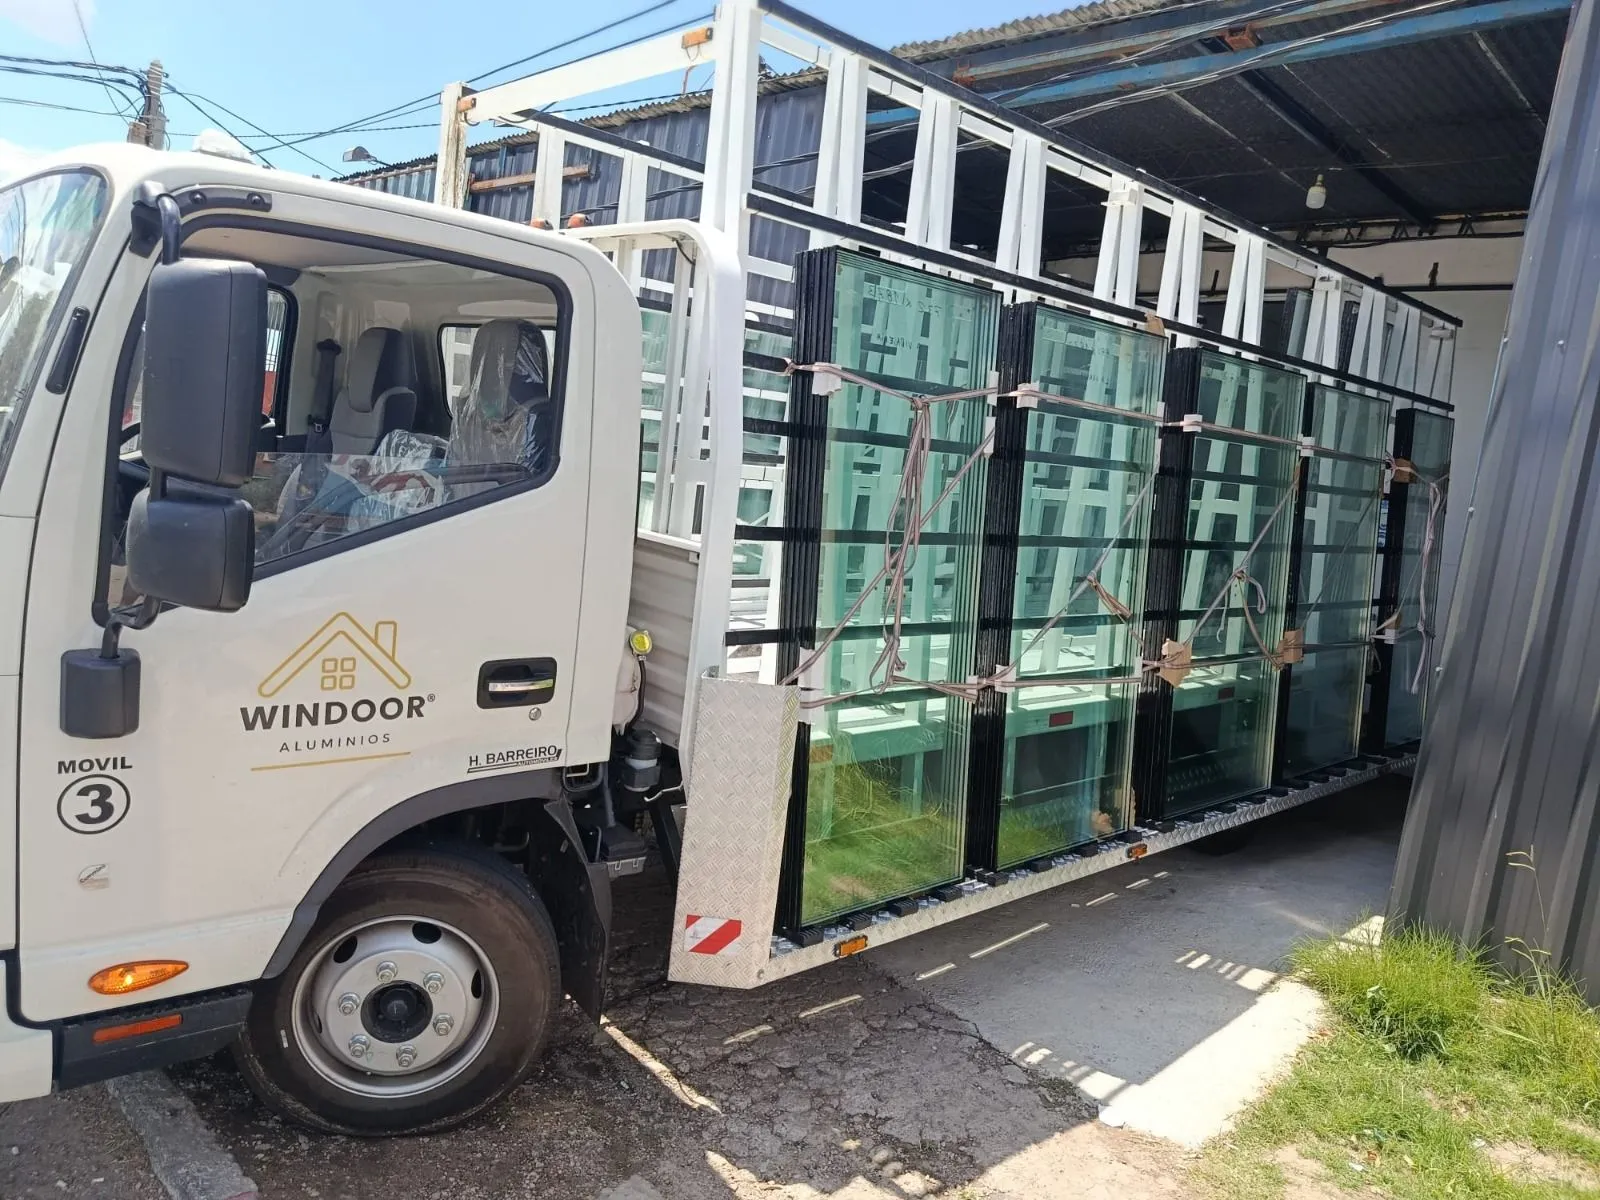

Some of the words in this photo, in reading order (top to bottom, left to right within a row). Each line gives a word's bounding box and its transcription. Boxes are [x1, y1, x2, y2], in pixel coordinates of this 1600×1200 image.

[279, 733, 392, 753] ALUMINIOS
[57, 756, 133, 774] MOVIL
[469, 755, 482, 767] H.
[486, 745, 557, 765] BARREIRO
[75, 783, 115, 825] 3
